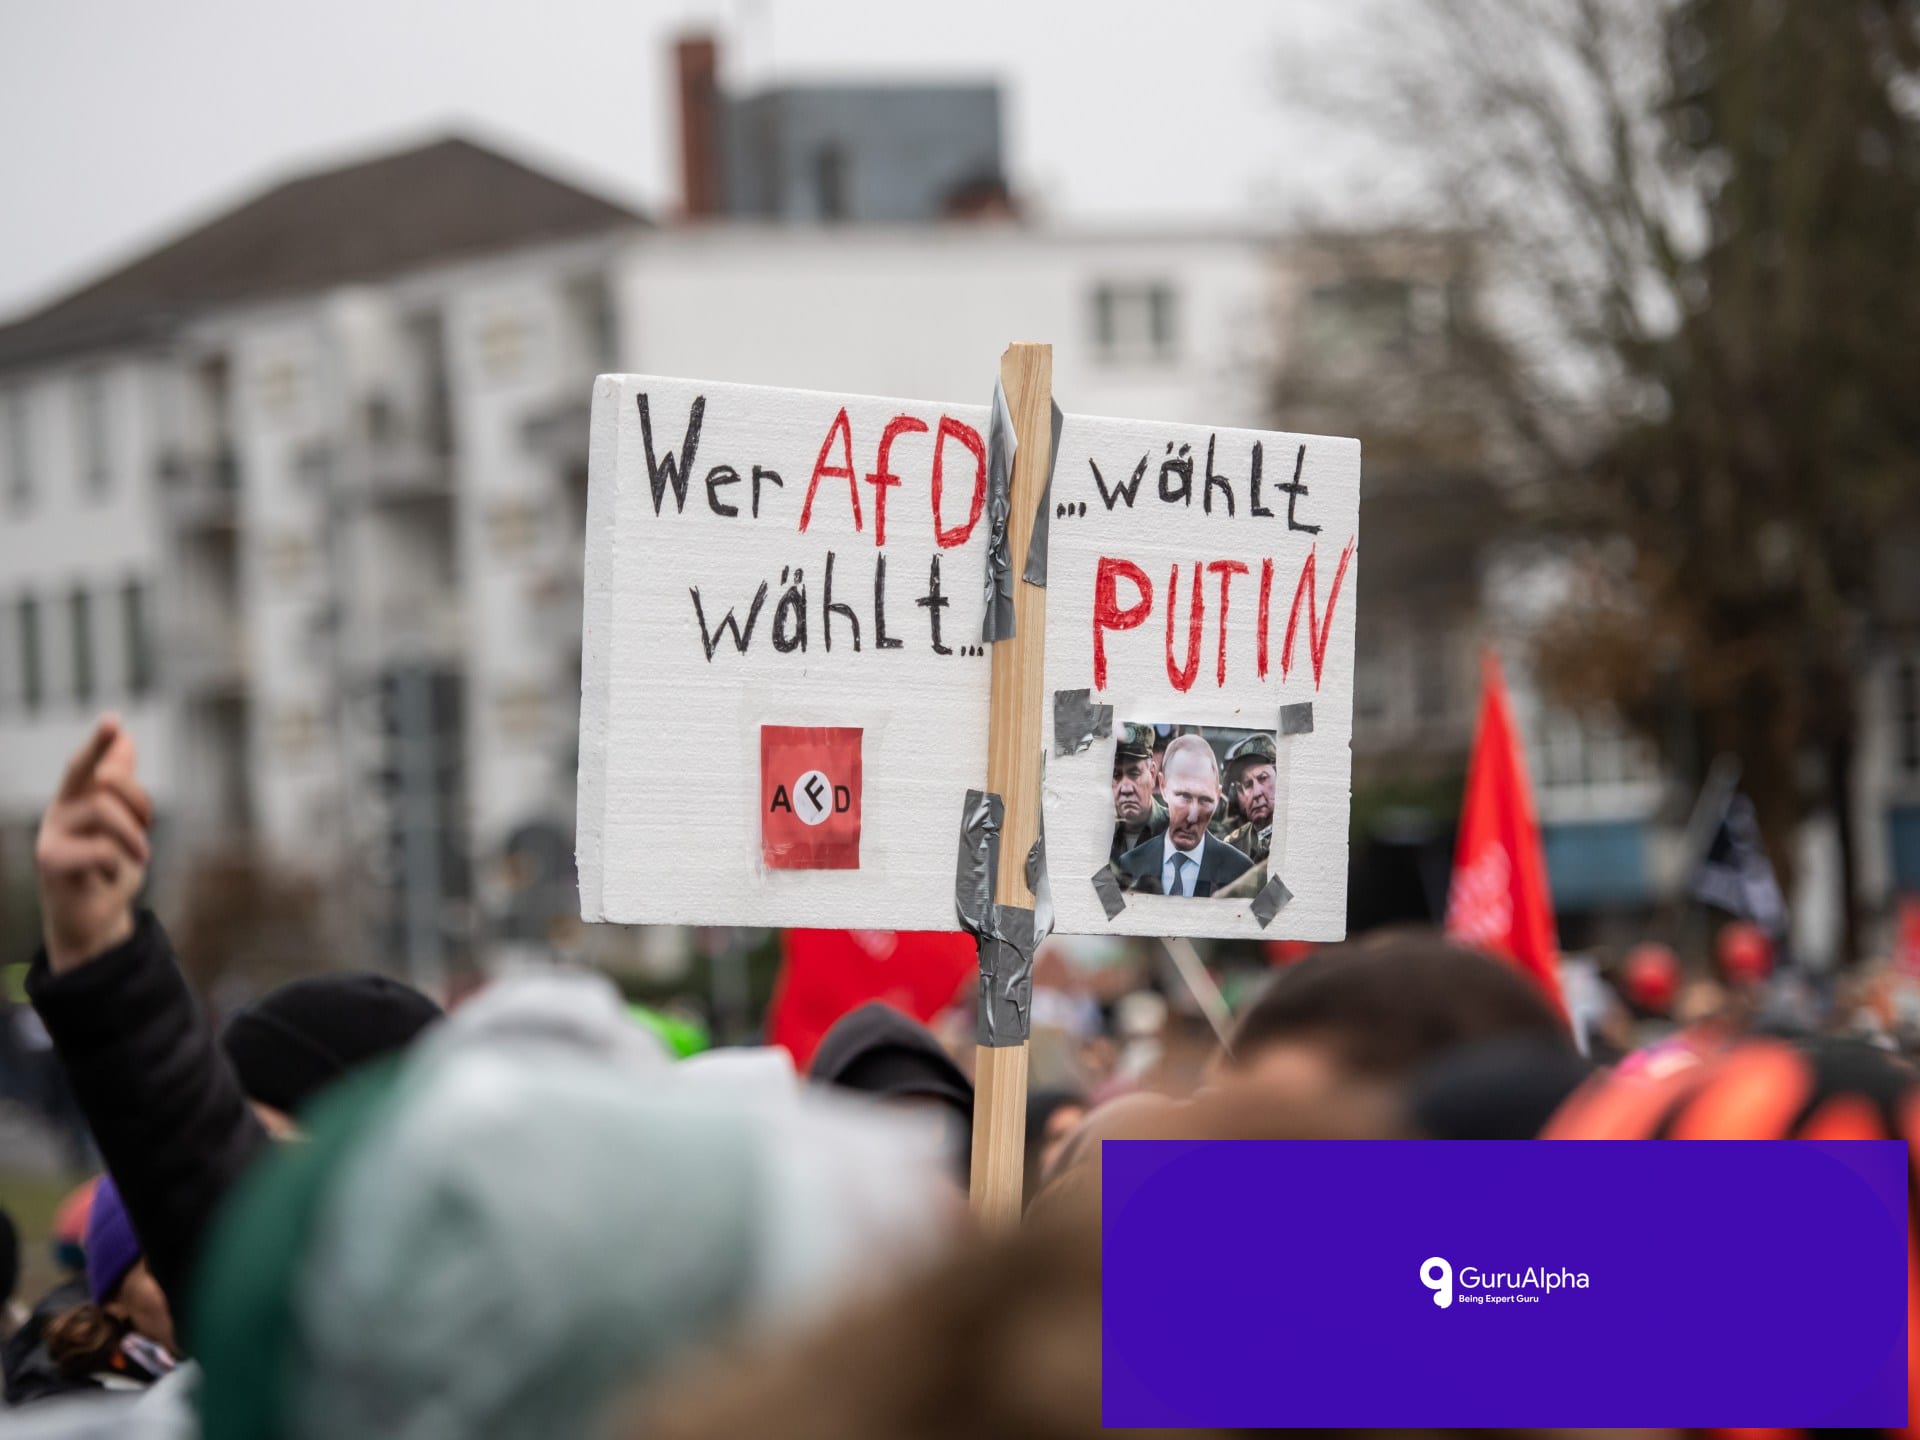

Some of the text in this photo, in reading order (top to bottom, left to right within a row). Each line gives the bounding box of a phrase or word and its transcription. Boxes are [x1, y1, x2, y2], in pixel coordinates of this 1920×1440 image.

[636, 393, 987, 549] Wer AfD
[1092, 536, 1354, 692] PUTIN
